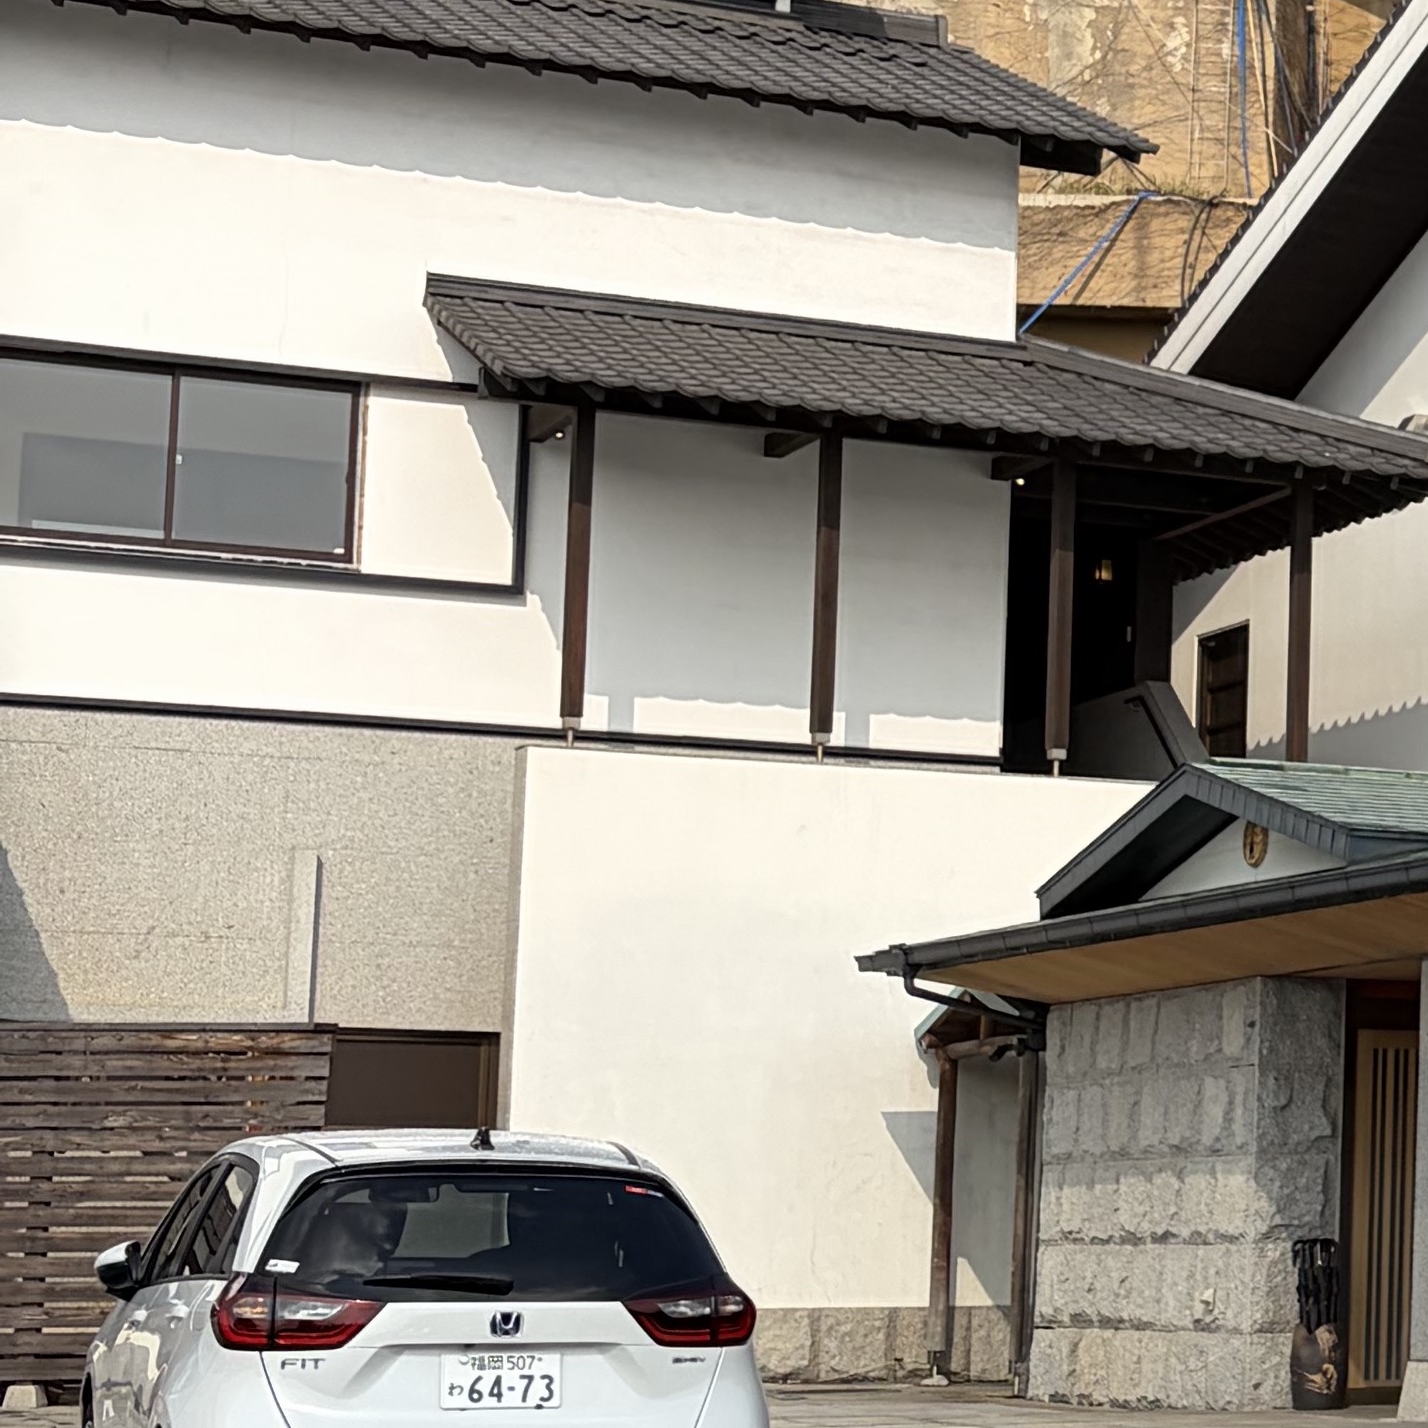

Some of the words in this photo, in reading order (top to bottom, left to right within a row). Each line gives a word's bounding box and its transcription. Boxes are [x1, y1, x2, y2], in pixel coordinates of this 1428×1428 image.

[280, 1358, 326, 1370] FIT
[506, 1355, 536, 1371] 507
[447, 1382, 465, 1397] わ
[467, 1374, 555, 1404] 64-73
